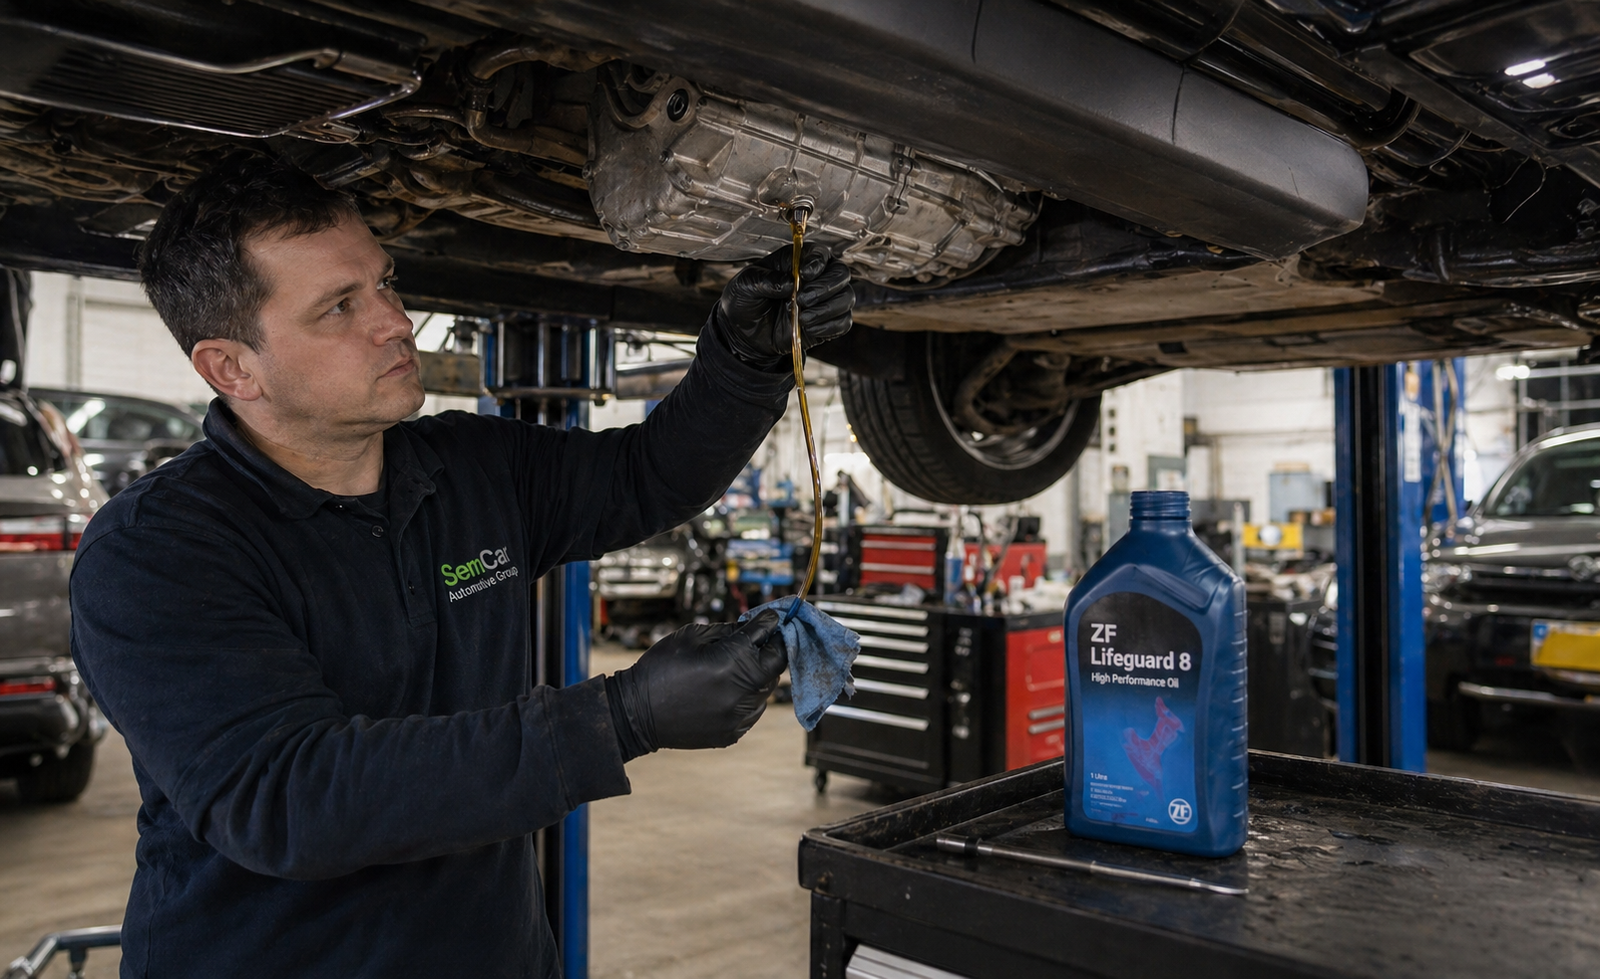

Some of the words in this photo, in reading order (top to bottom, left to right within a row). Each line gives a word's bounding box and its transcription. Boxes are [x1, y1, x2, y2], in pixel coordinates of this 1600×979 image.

[441, 546, 510, 586] SemCar
[449, 577, 497, 602] Automotive
[495, 566, 519, 581] Group
[1091, 623, 1117, 643] ZF
[1091, 646, 1174, 671] Lifeguard
[1179, 652, 1191, 671] 8
[1091, 672, 1110, 685] High
[1112, 673, 1166, 687] Performance
[1167, 677, 1179, 688] Oil
